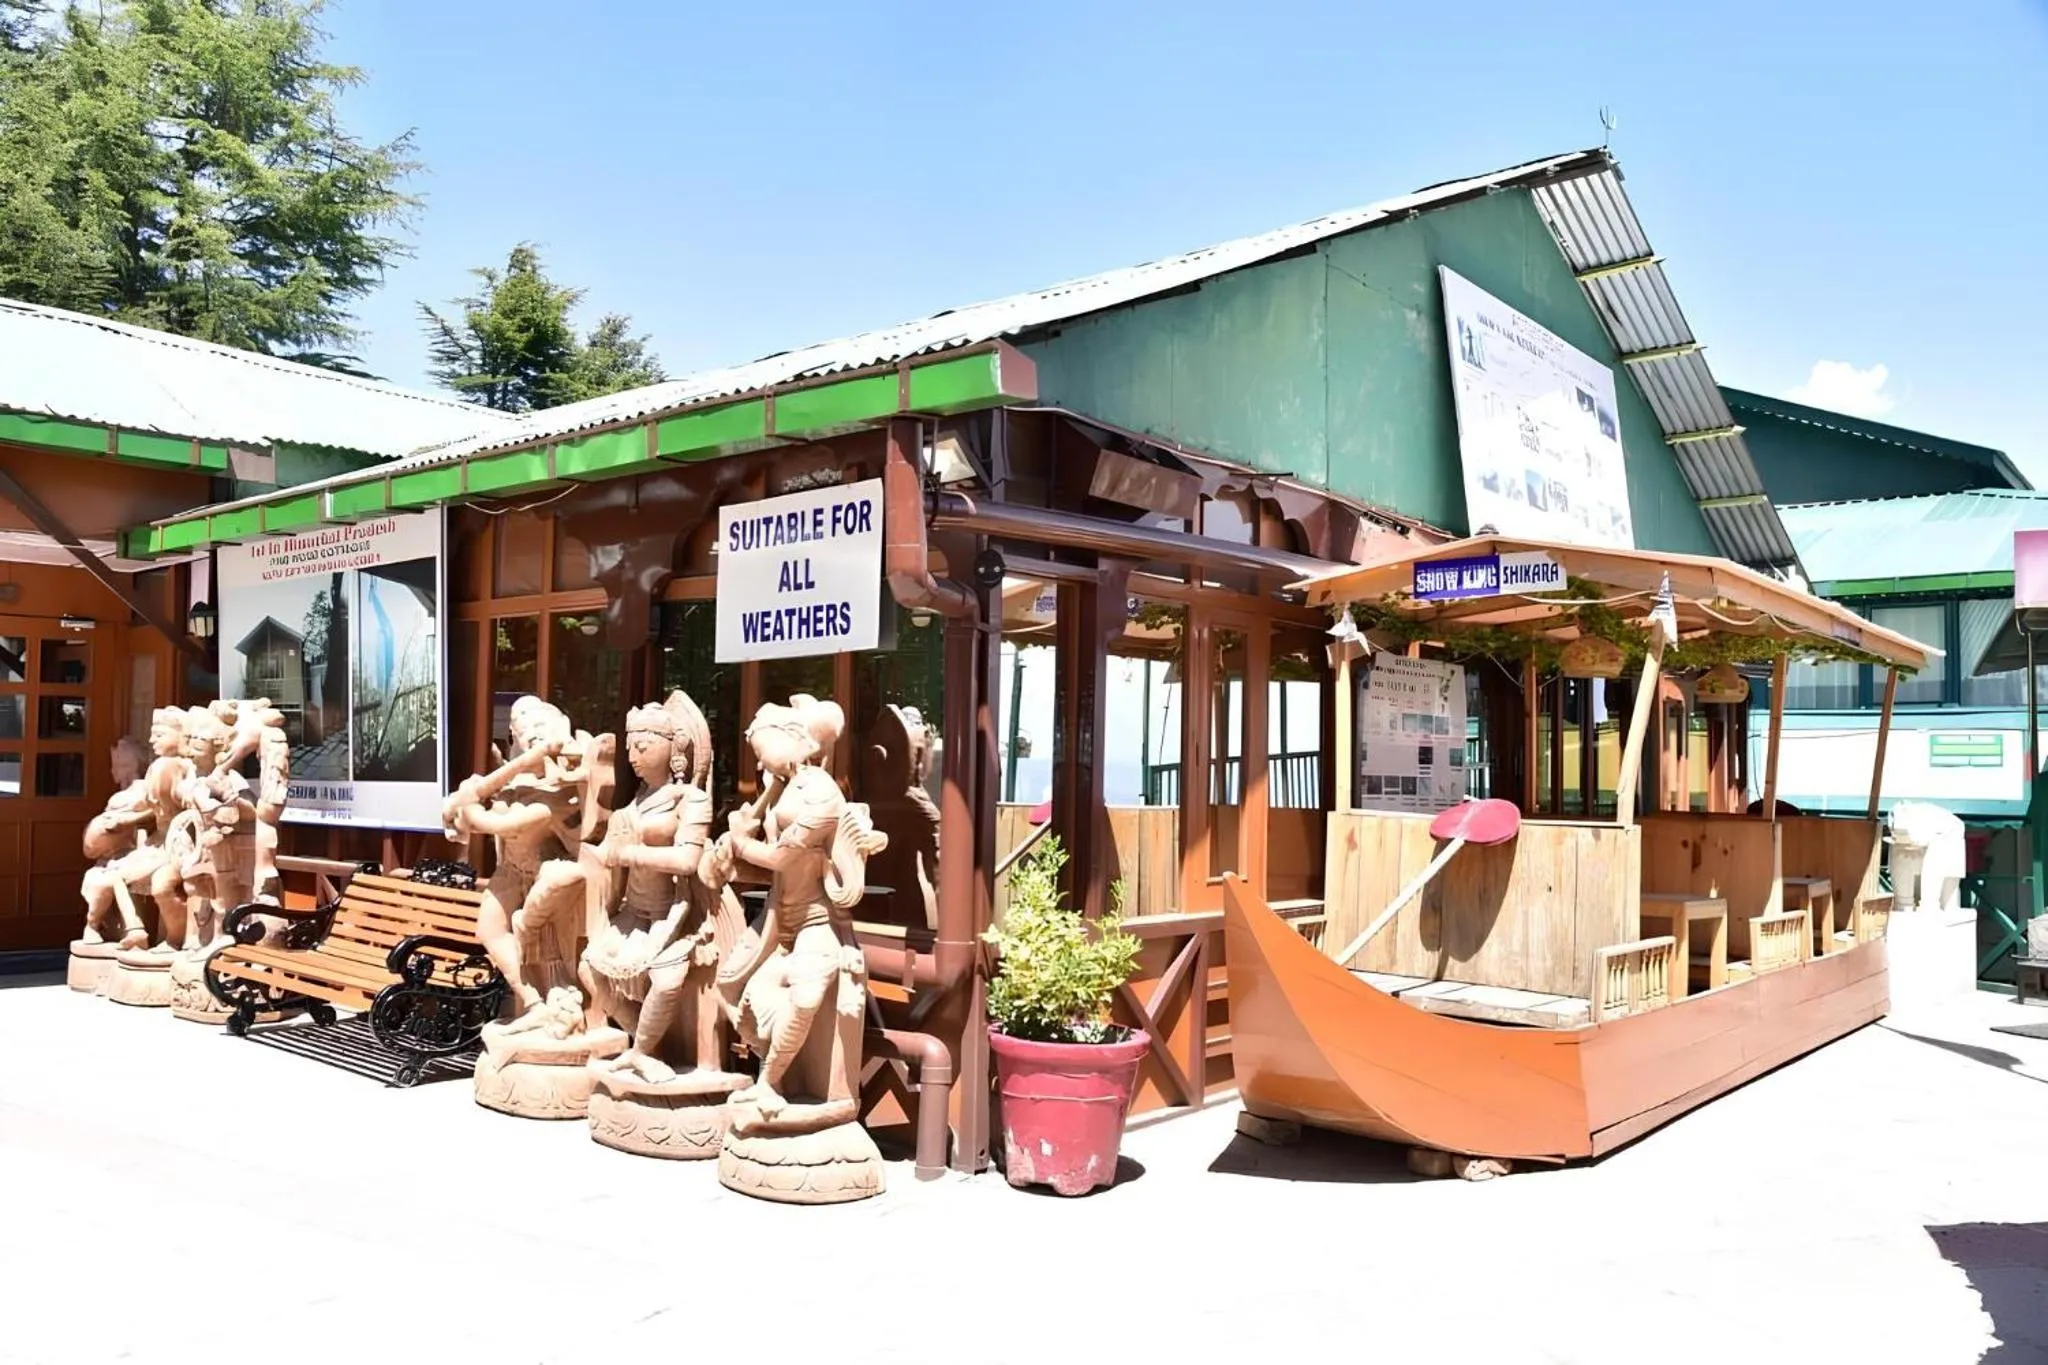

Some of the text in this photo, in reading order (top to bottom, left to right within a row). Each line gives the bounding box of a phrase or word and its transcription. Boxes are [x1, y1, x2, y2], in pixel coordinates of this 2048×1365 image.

[729, 499, 872, 552] SUITABLE FOR
[778, 558, 816, 593] ALL
[1502, 562, 1559, 585] SHIKARA
[742, 601, 851, 644] WEATHERS
